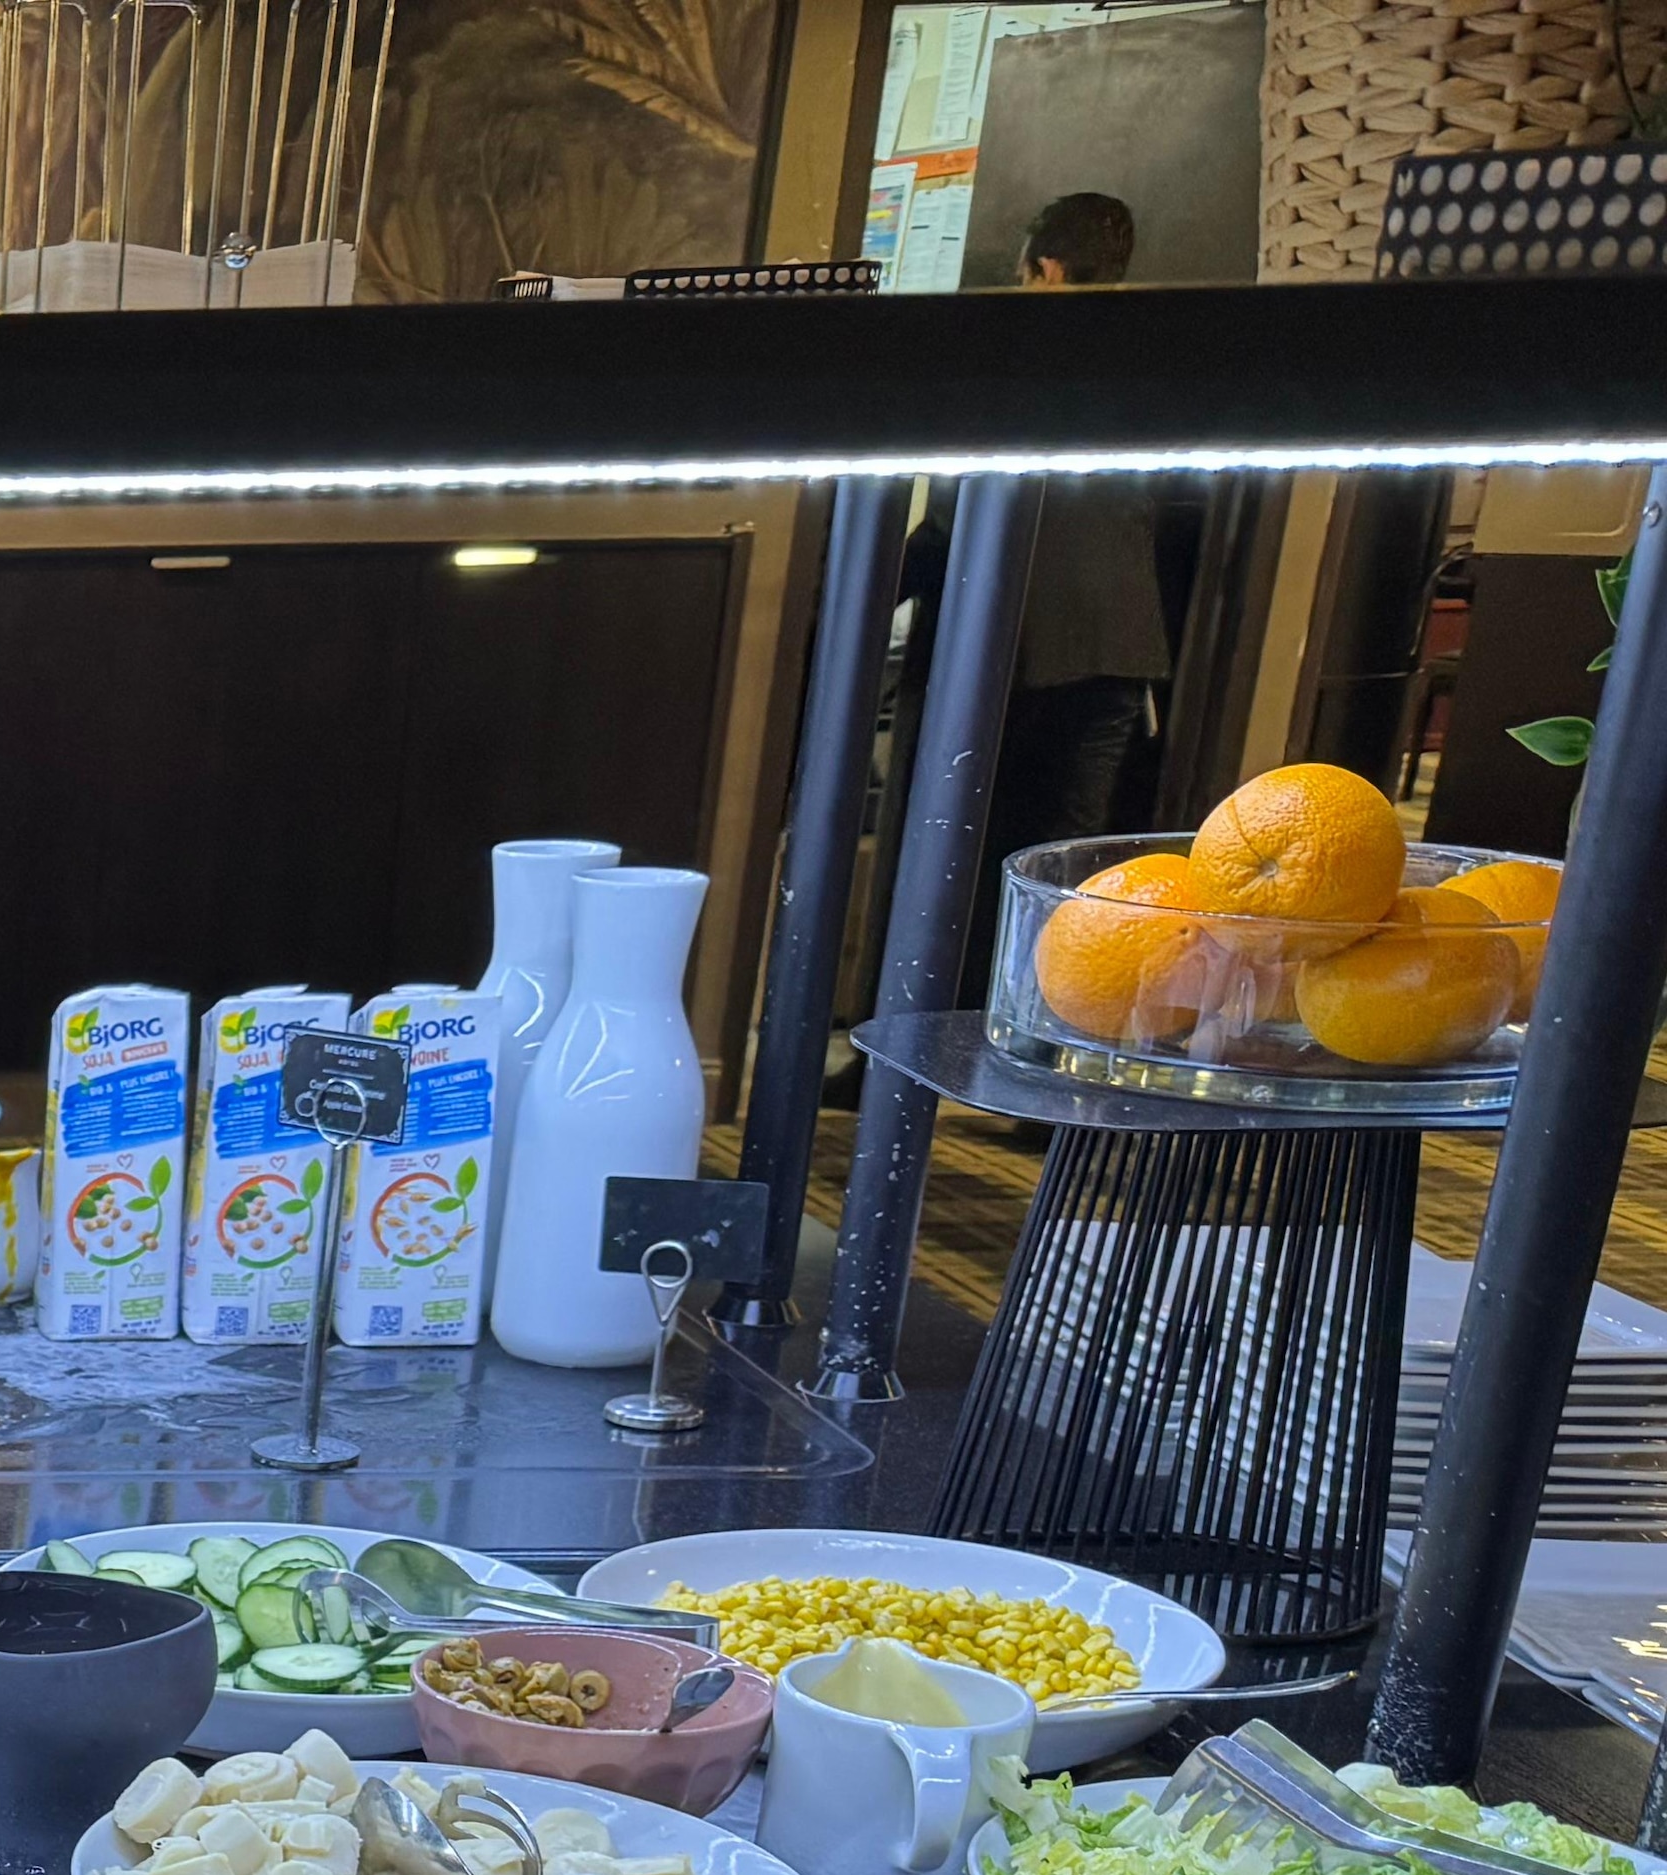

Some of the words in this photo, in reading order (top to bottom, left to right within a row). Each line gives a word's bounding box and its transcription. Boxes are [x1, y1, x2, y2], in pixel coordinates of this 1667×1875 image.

[82, 1051, 114, 1069] SOJA
[237, 1051, 269, 1070] SOJA
[323, 1043, 377, 1061] MERCURE
[410, 1047, 449, 1067] VOINE
